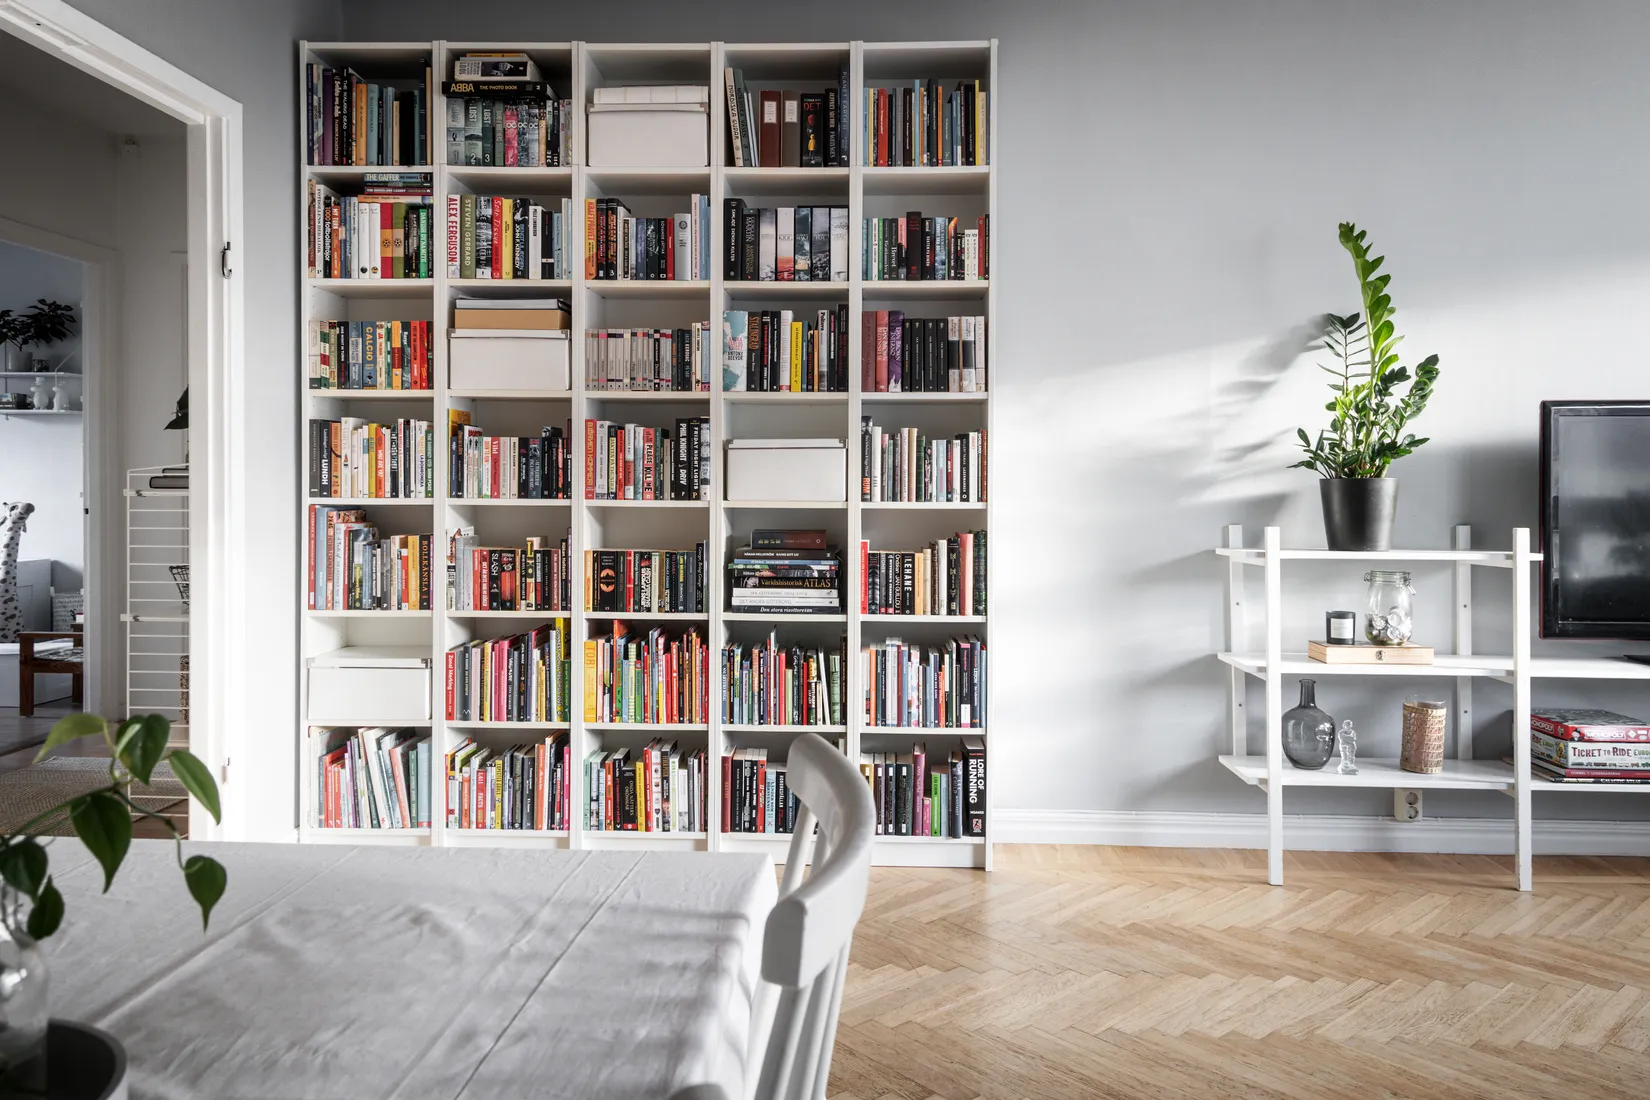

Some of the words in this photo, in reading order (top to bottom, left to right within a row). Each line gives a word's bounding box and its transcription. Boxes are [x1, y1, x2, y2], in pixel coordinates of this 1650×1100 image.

[450, 83, 474, 92] ABBA
[803, 102, 820, 111] DET
[469, 106, 477, 122] LOST
[470, 153, 476, 162] 2
[484, 154, 490, 162] 3
[333, 208, 339, 216] MY
[448, 197, 458, 218] ALEX
[448, 220, 458, 263] FERGUSON
[749, 316, 760, 350] STALINGRAD
[679, 423, 687, 437] PHIL
[644, 445, 653, 464] PLEASE
[679, 438, 687, 461] KNIGHT
[644, 466, 653, 480] KILL
[679, 469, 687, 485] DRIV
[644, 482, 653, 492] ME
[904, 558, 912, 592] LEHANE
[803, 579, 831, 587] ATLAS
[1571, 746, 1601, 757] TICKET
[1612, 746, 1632, 757] RIDE
[969, 759, 977, 804] RUNNING
[978, 779, 984, 790] OF
[477, 792, 485, 808] FACTS
